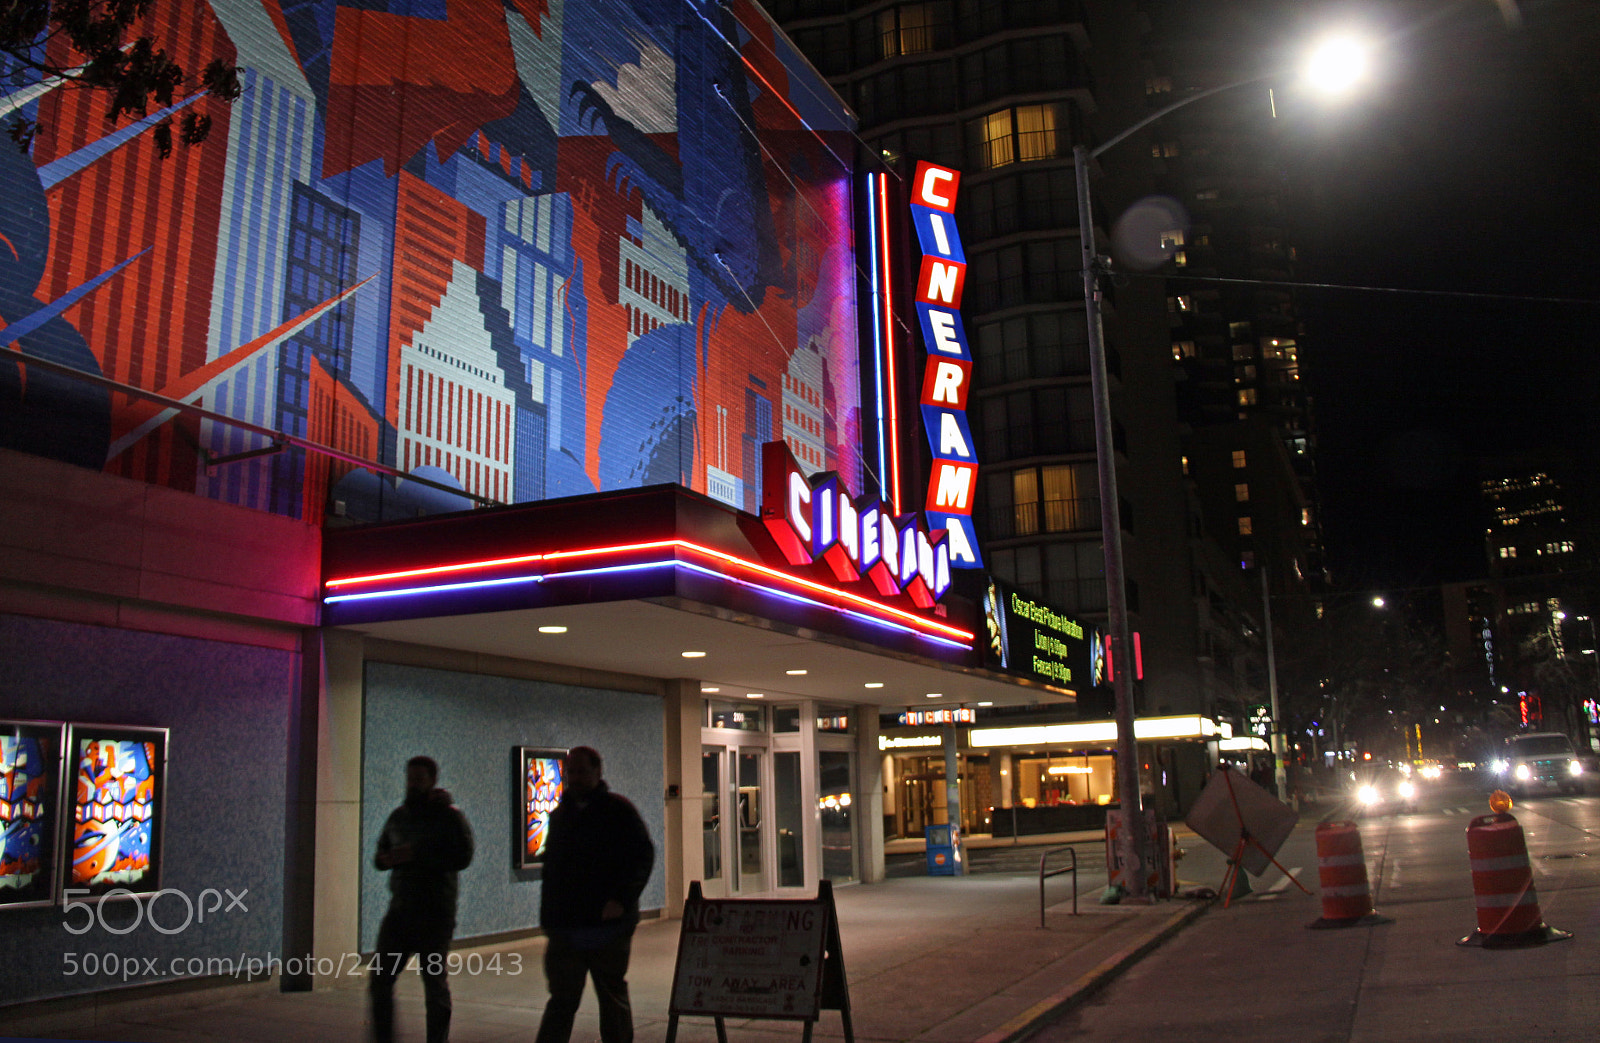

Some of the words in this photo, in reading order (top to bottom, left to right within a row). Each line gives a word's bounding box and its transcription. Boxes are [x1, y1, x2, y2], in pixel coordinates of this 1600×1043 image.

[920, 167, 976, 563] CINERAMA
[789, 471, 950, 594] CINERAMA
[907, 709, 970, 724] TICKETS
[687, 975, 713, 988] TOW
[721, 976, 758, 990] AWAY
[769, 978, 806, 991] AREA
